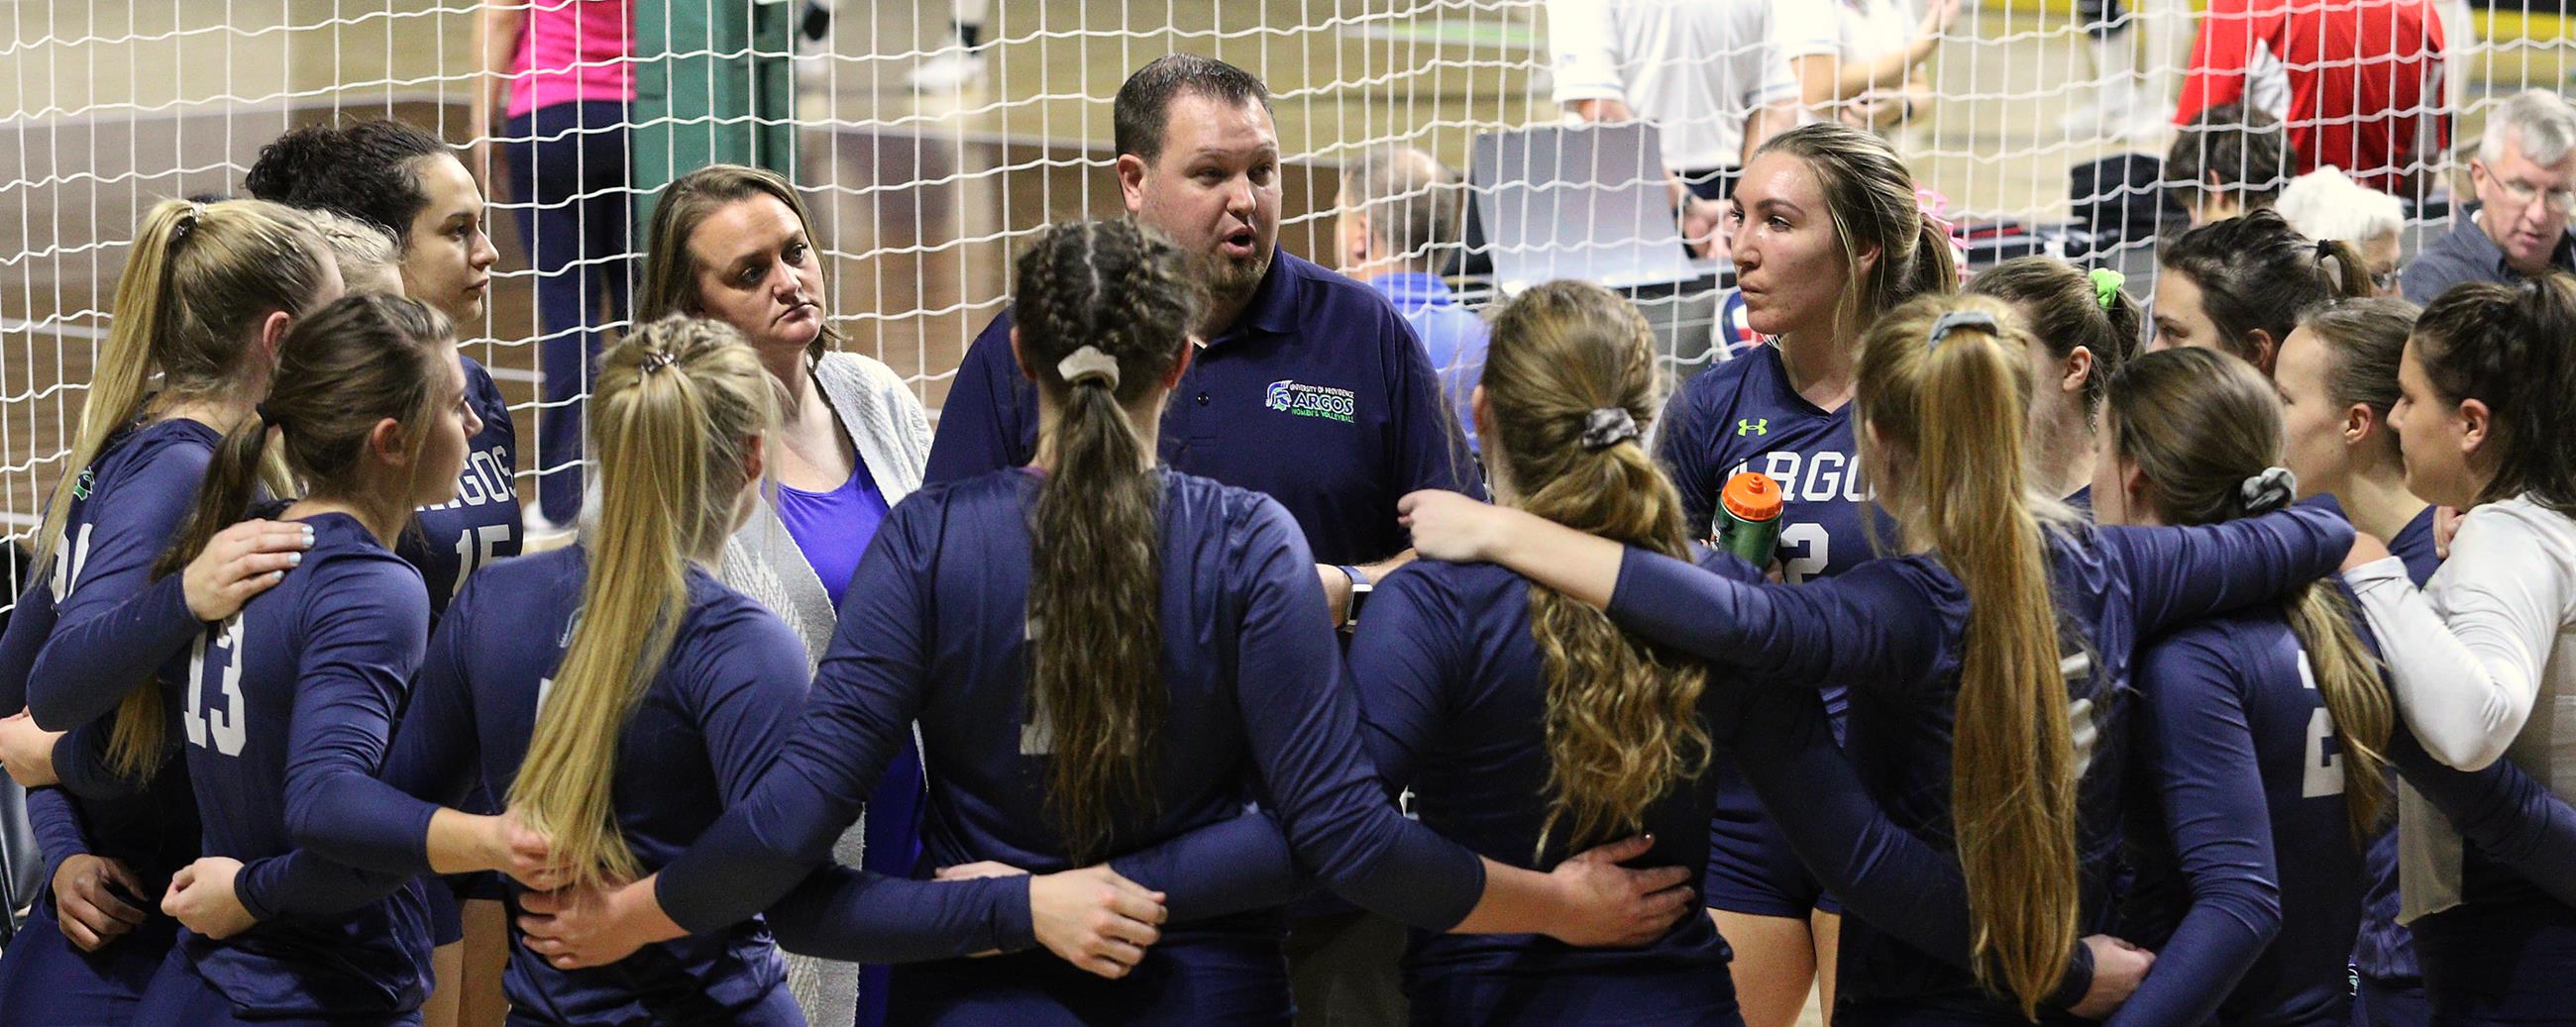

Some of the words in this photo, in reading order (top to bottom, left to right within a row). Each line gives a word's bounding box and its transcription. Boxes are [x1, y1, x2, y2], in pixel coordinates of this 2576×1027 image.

[1289, 383, 1317, 392] UNIVERSITY
[1325, 387, 1354, 398] PROVIDENCE
[1292, 392, 1354, 415] ARGOS
[1321, 411, 1354, 423] VOLLEYBALL
[414, 445, 517, 511] GOS
[183, 611, 247, 757] 13
